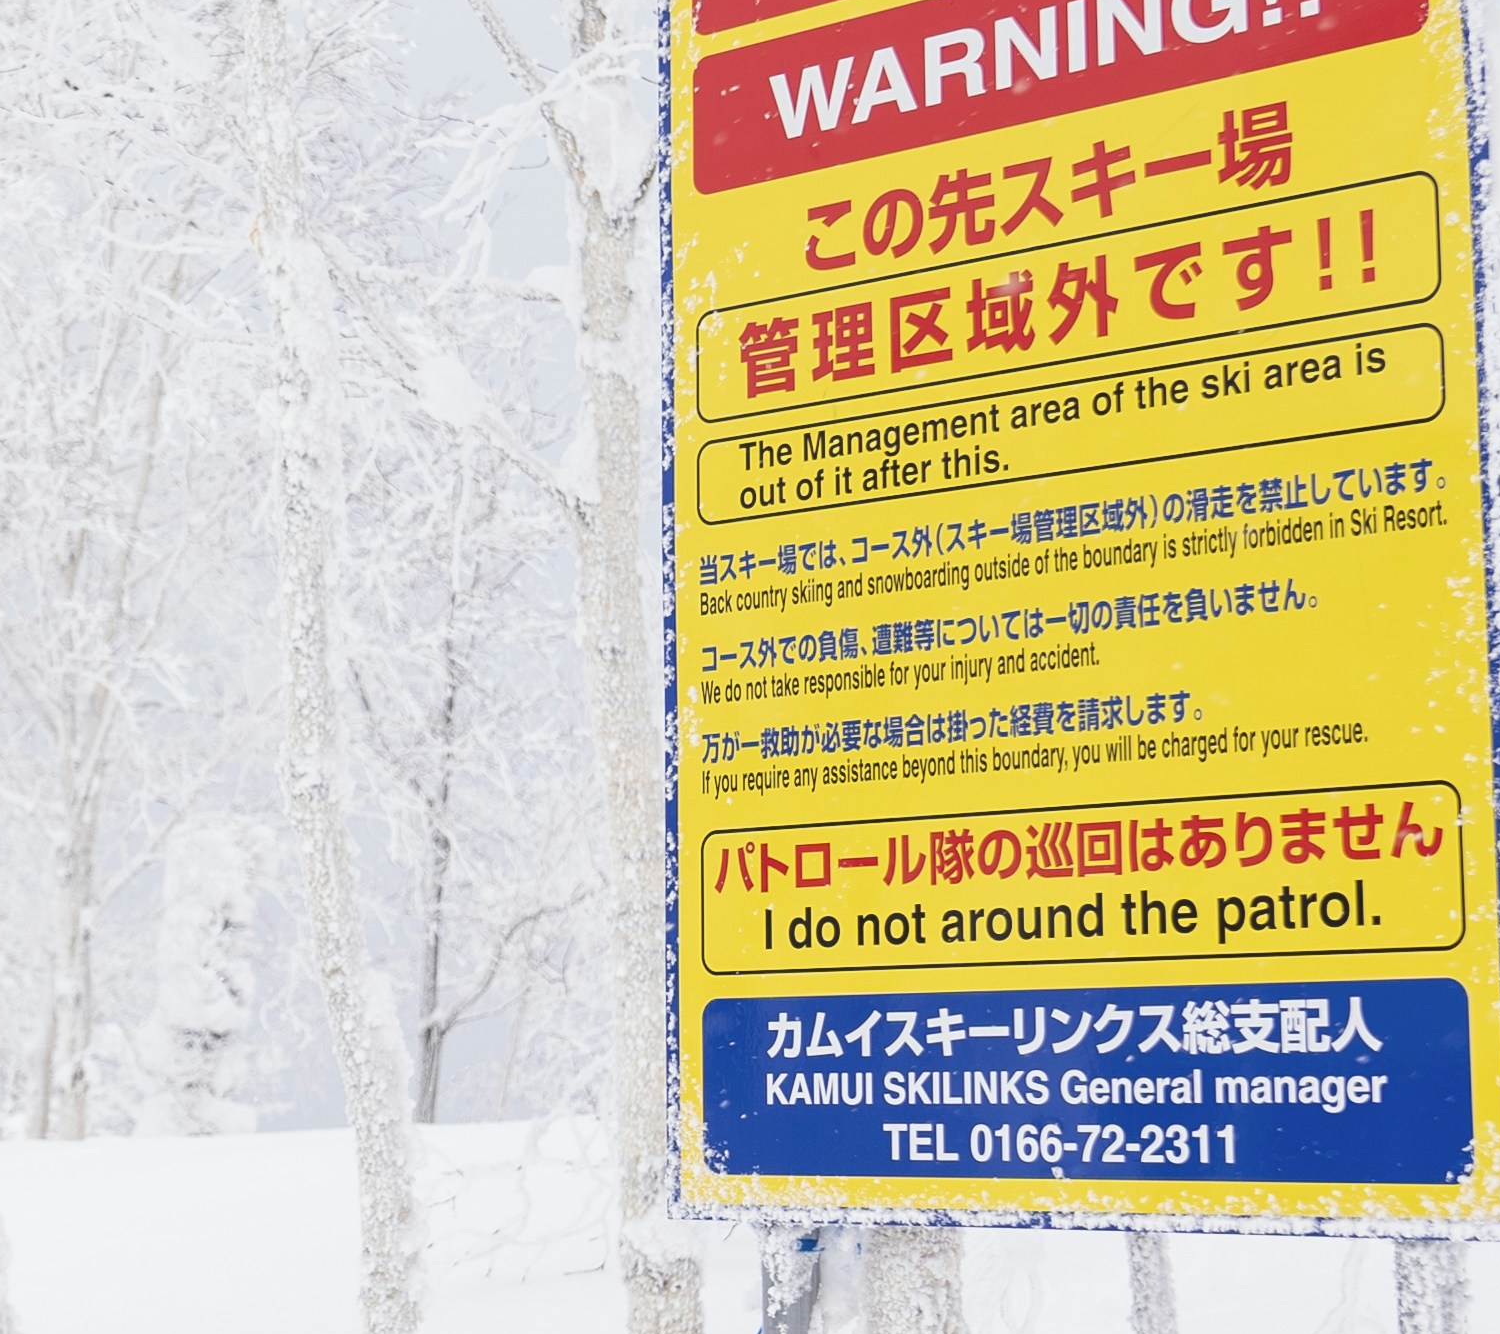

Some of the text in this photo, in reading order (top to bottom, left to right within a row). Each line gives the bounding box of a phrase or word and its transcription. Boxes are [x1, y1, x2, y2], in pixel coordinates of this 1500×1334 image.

[805, 100, 1293, 271] この先スキー場
[738, 342, 1386, 471] The Management area of the ski area is
[740, 444, 1009, 510] out of it after this.
[700, 500, 1447, 616] Back country skiing and snowboarding outside of the boundary is strictly forbidden in Ski Resort.
[701, 642, 1100, 705] We do not take responsible for your injury and accident.
[702, 770, 710, 794] If
[714, 774, 738, 800] you
[742, 764, 790, 796] require
[794, 767, 818, 792] any
[822, 758, 898, 785] assistance
[902, 750, 956, 784] beyond
[960, 747, 988, 774] this
[1072, 744, 1101, 772] you
[1105, 735, 1131, 762] will
[1137, 734, 1157, 760] be
[1162, 727, 1228, 763] charged
[1233, 726, 1256, 752] for
[1261, 727, 1299, 758] your
[1305, 722, 1368, 747] rescue.
[714, 801, 1443, 894] パトロール隊の巡回はありません
[765, 879, 1381, 950] I do not around the patrol.
[767, 996, 1383, 1058] カムイスキーリンクス総支配人
[766, 1068, 1388, 1112] KAMUI SKILINKS General manager
[882, 1123, 1235, 1164] TEL 0166-72-2311
